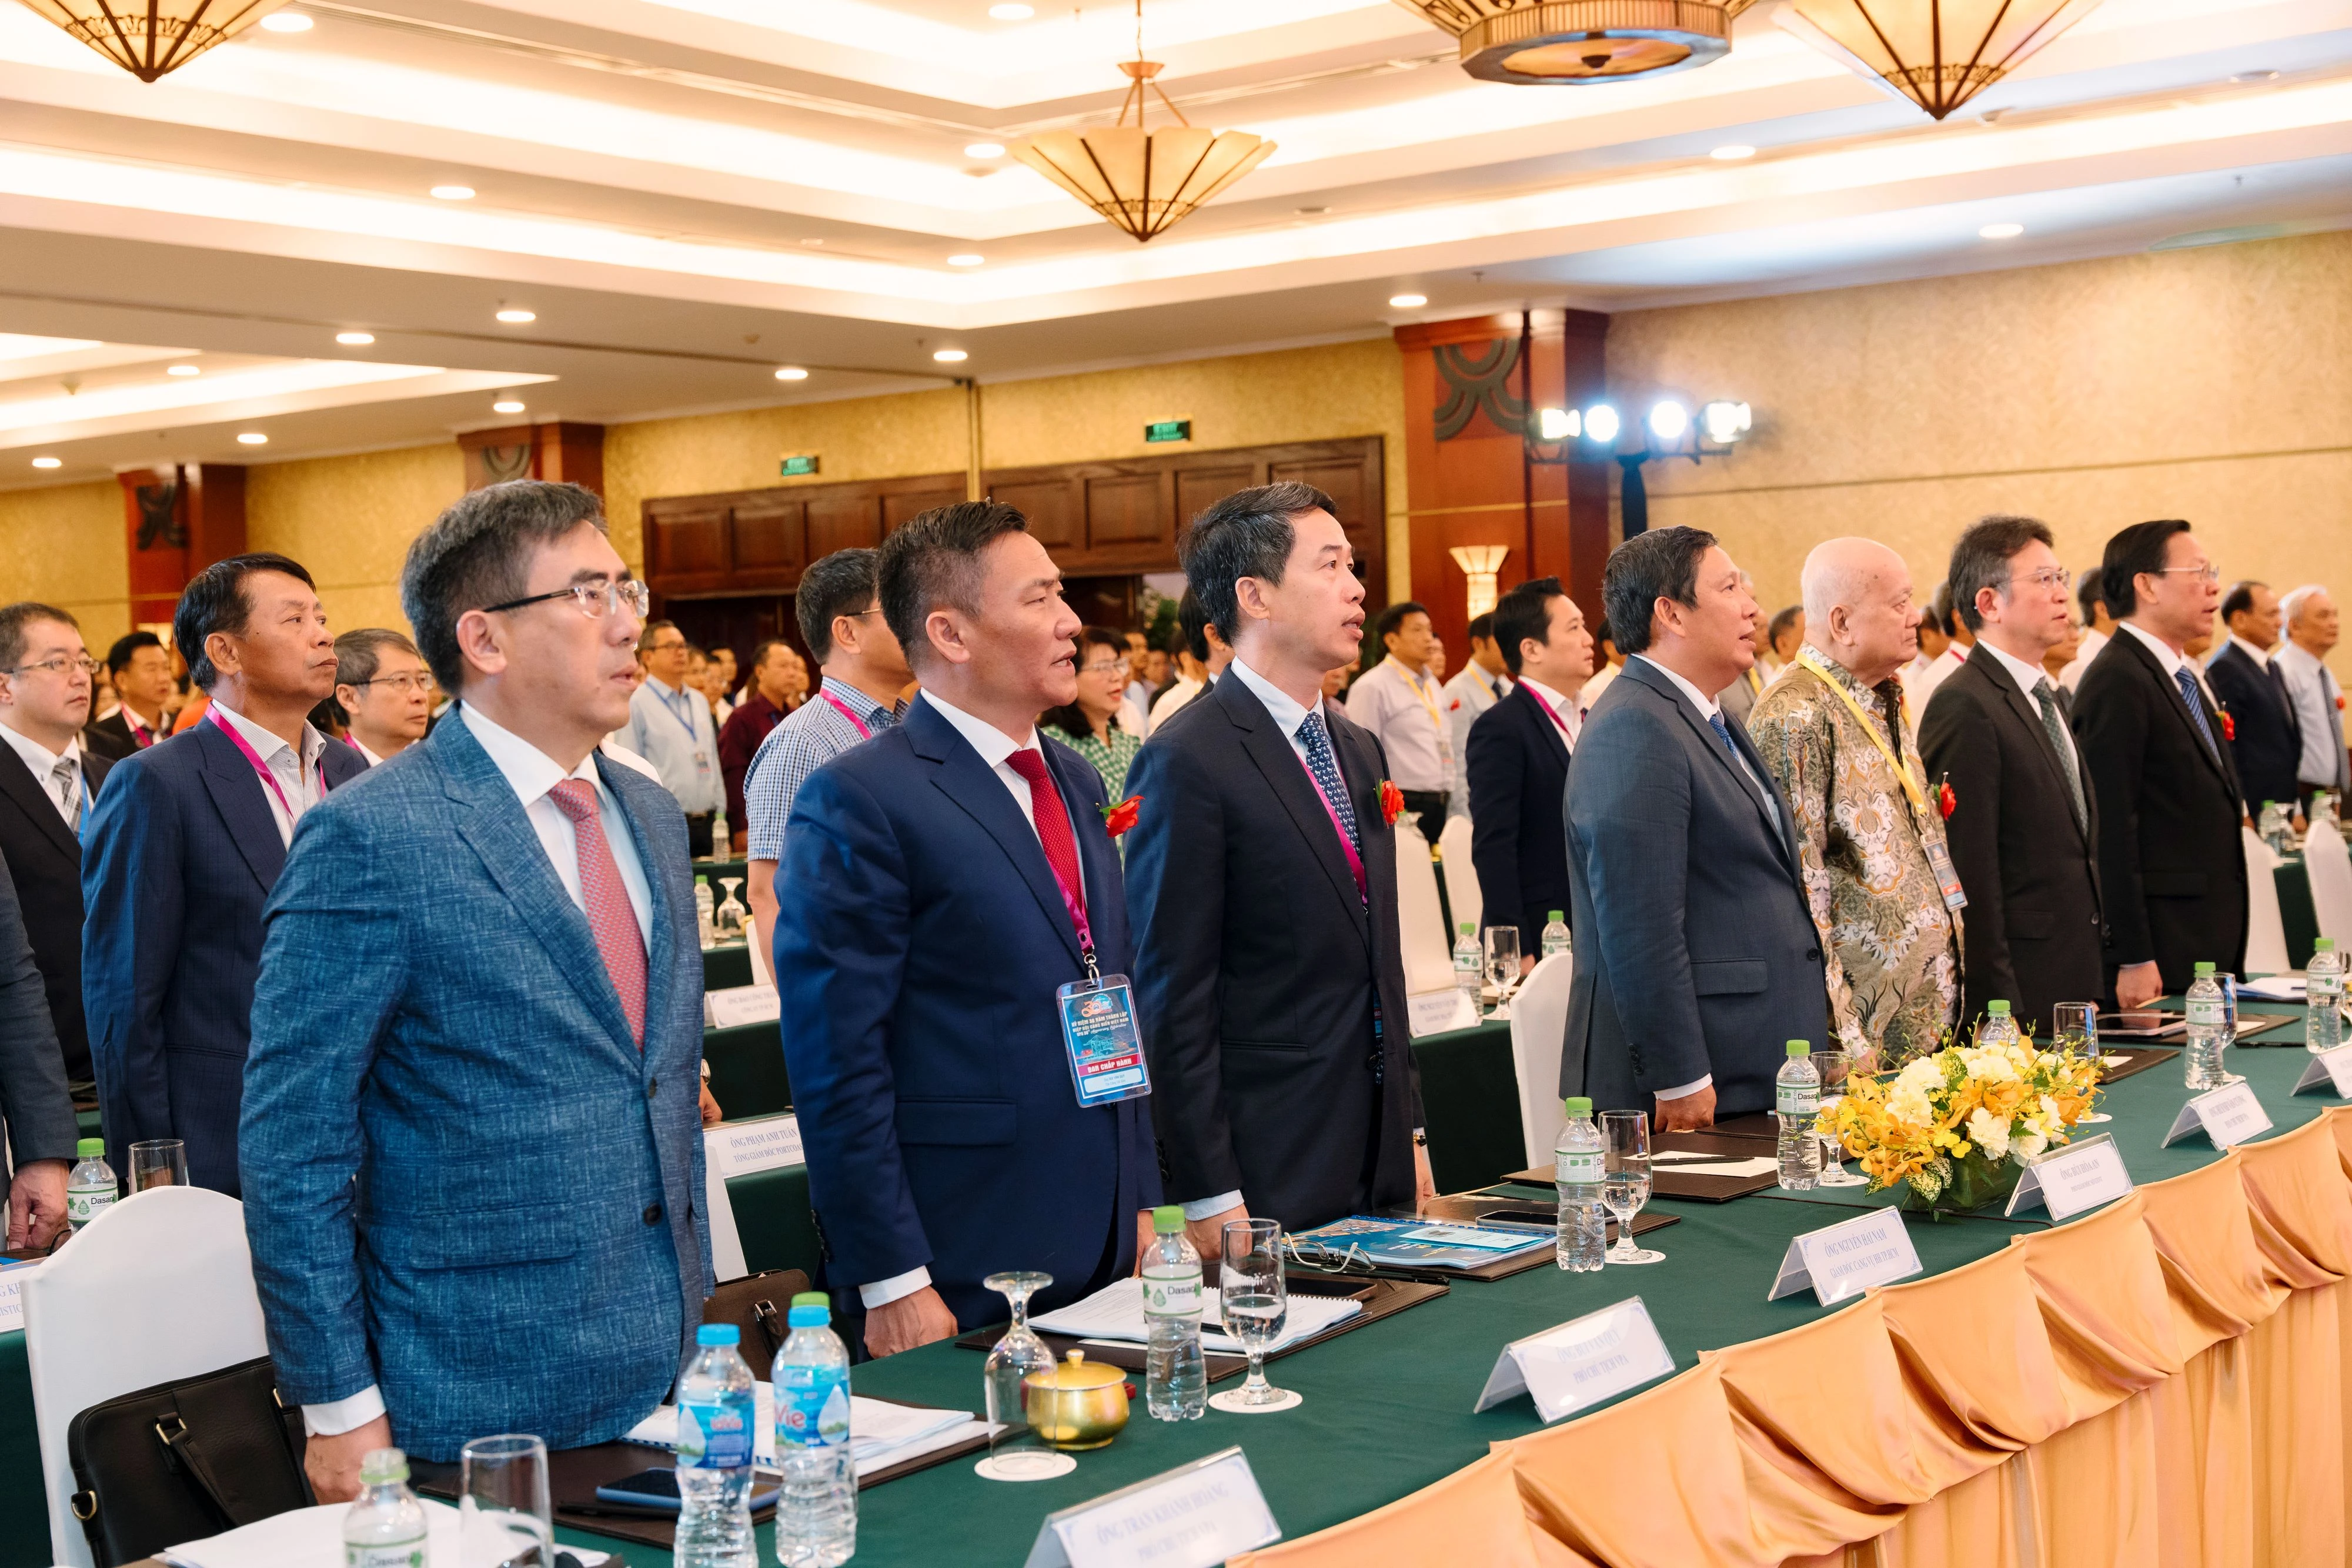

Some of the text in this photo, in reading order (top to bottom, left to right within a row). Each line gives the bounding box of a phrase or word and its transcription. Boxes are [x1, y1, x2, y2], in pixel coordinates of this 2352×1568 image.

[1100, 1061, 1115, 1070] CHẤP
[1116, 1058, 1132, 1066] HÀNH
[730, 1137, 746, 1148] ÔNG
[746, 1134, 766, 1146] PHẠM
[765, 1131, 780, 1142] ANH
[750, 1149, 765, 1160] GIÁM
[764, 1147, 777, 1156] ĐỐC
[1825, 1242, 1839, 1258] ÔNG
[1872, 1228, 1887, 1242] NAM
[1168, 1286, 1195, 1295] Dasan
[1613, 1353, 1629, 1366] VPA
